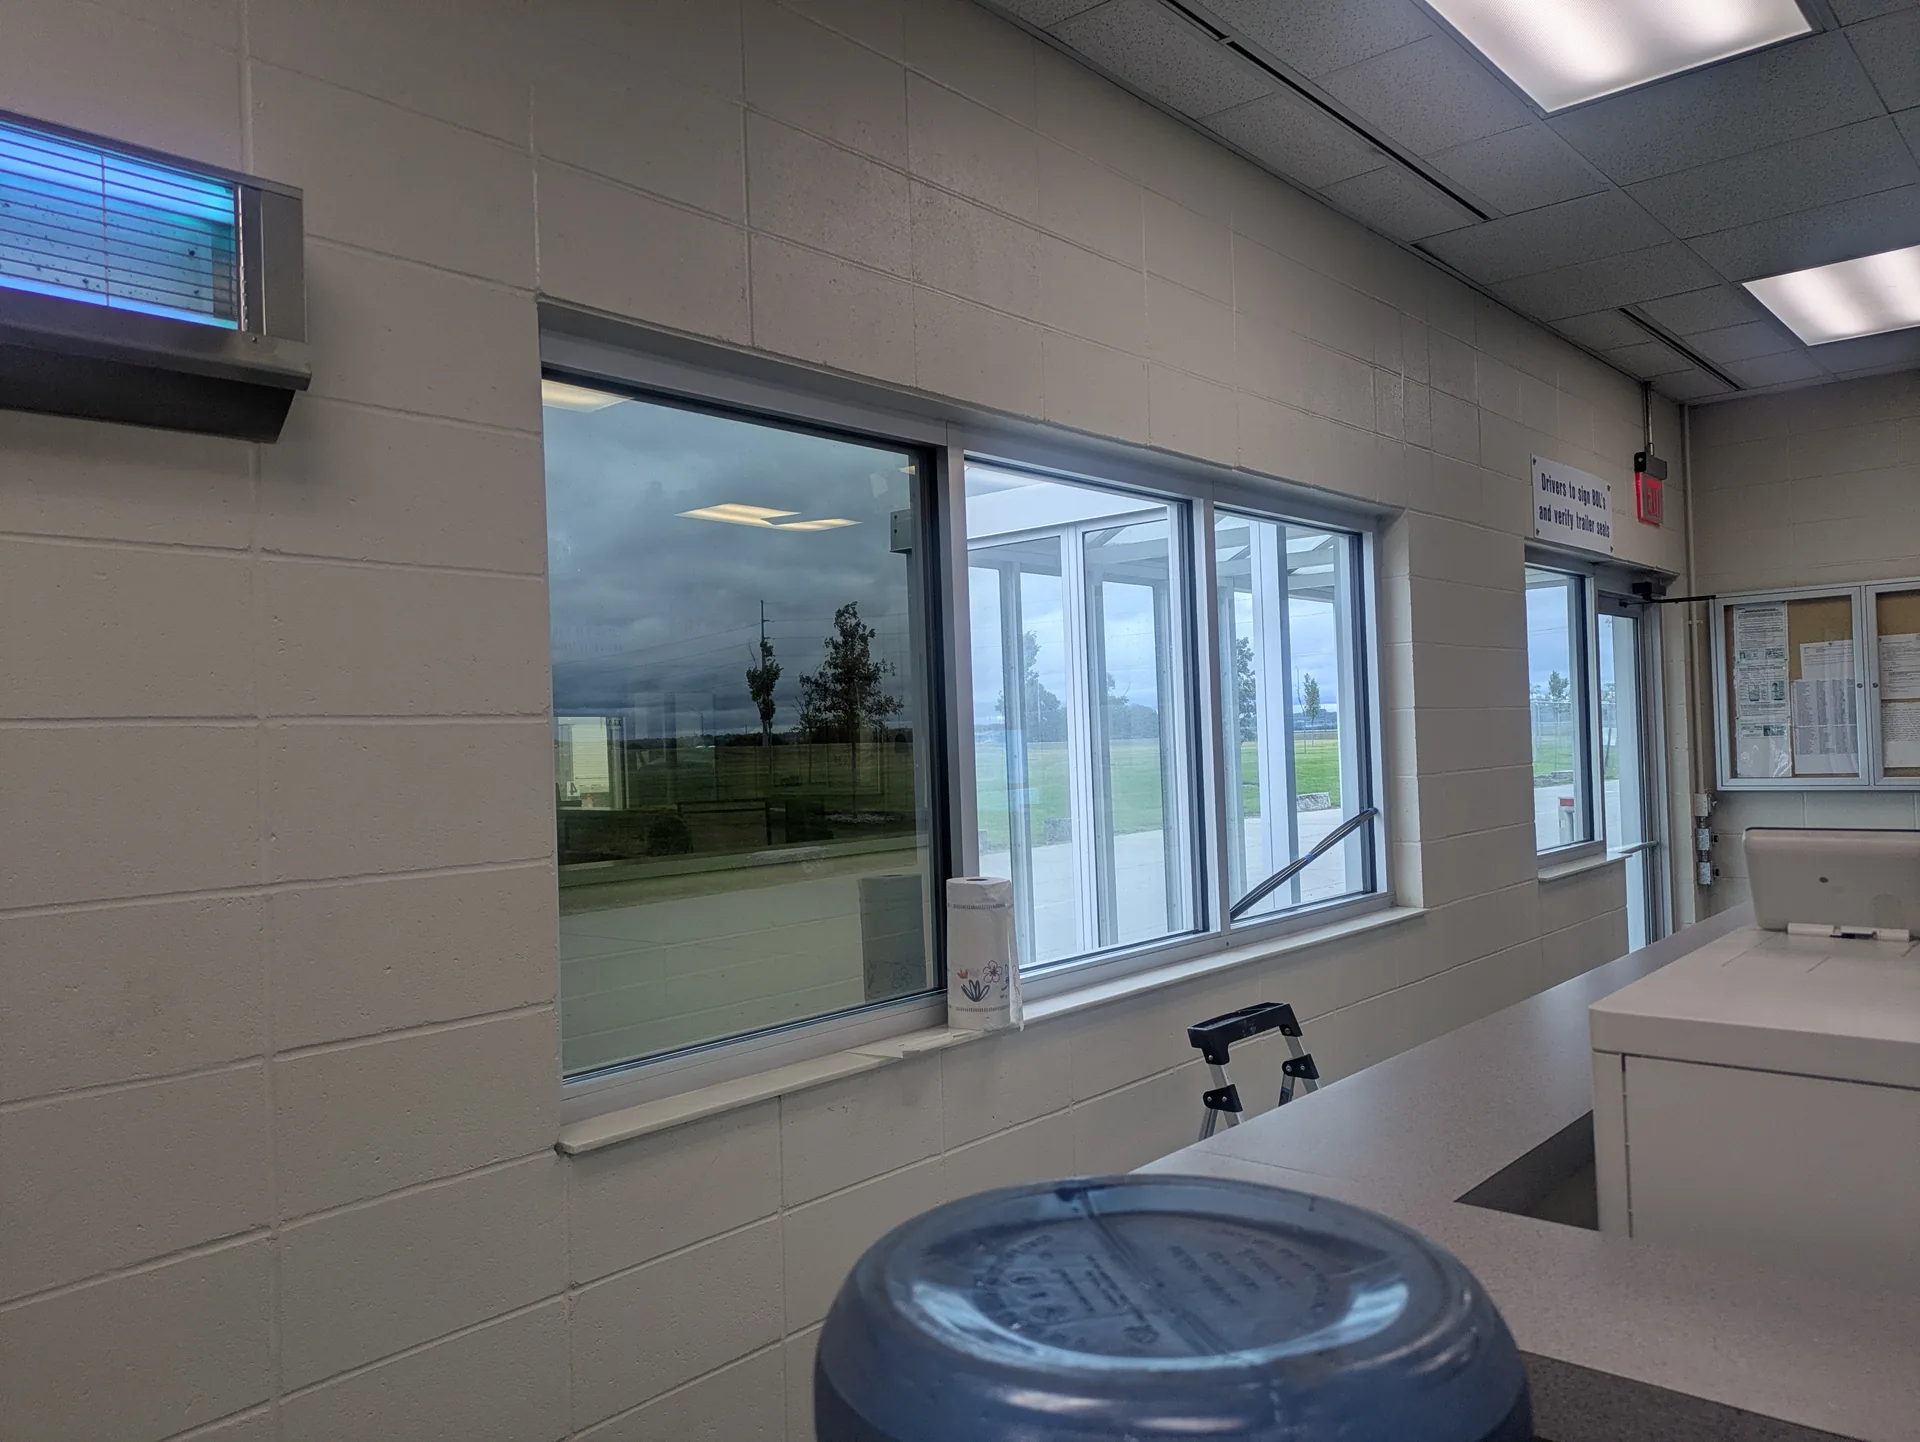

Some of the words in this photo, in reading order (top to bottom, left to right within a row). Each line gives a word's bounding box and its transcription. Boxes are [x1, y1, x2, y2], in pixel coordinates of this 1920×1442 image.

[1541, 473, 1566, 496] Drivers
[1569, 481, 1575, 499] to
[1578, 485, 1590, 506] sign
[1592, 489, 1606, 510] BOL's
[1646, 484, 1661, 517] EXIT
[1539, 504, 1551, 521] and
[1554, 509, 1573, 530] verify
[1576, 512, 1594, 533] trailer
[1597, 521, 1609, 538] seals
